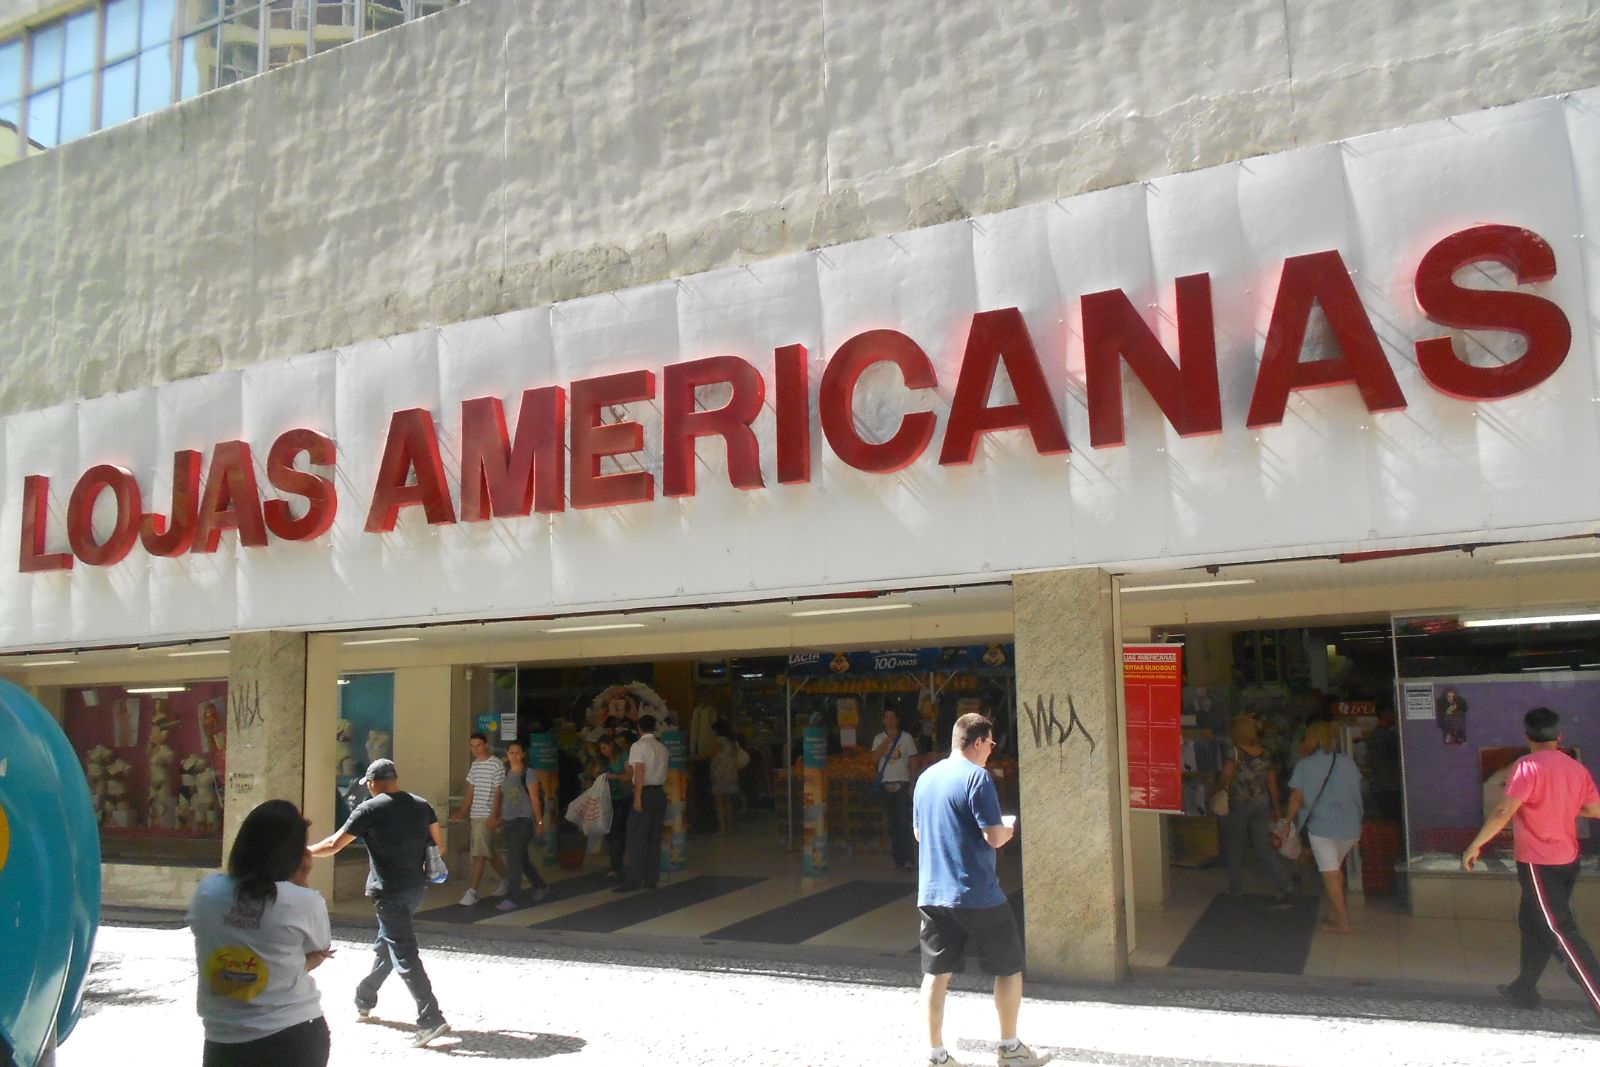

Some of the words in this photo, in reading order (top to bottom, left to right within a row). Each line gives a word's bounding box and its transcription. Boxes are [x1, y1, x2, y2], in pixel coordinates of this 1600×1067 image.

[19, 428, 338, 573] LOJAS
[364, 222, 1573, 534] AMERICANAS
[788, 652, 820, 665] LACTA
[874, 656, 897, 670] 100
[897, 658, 918, 667] ANOS
